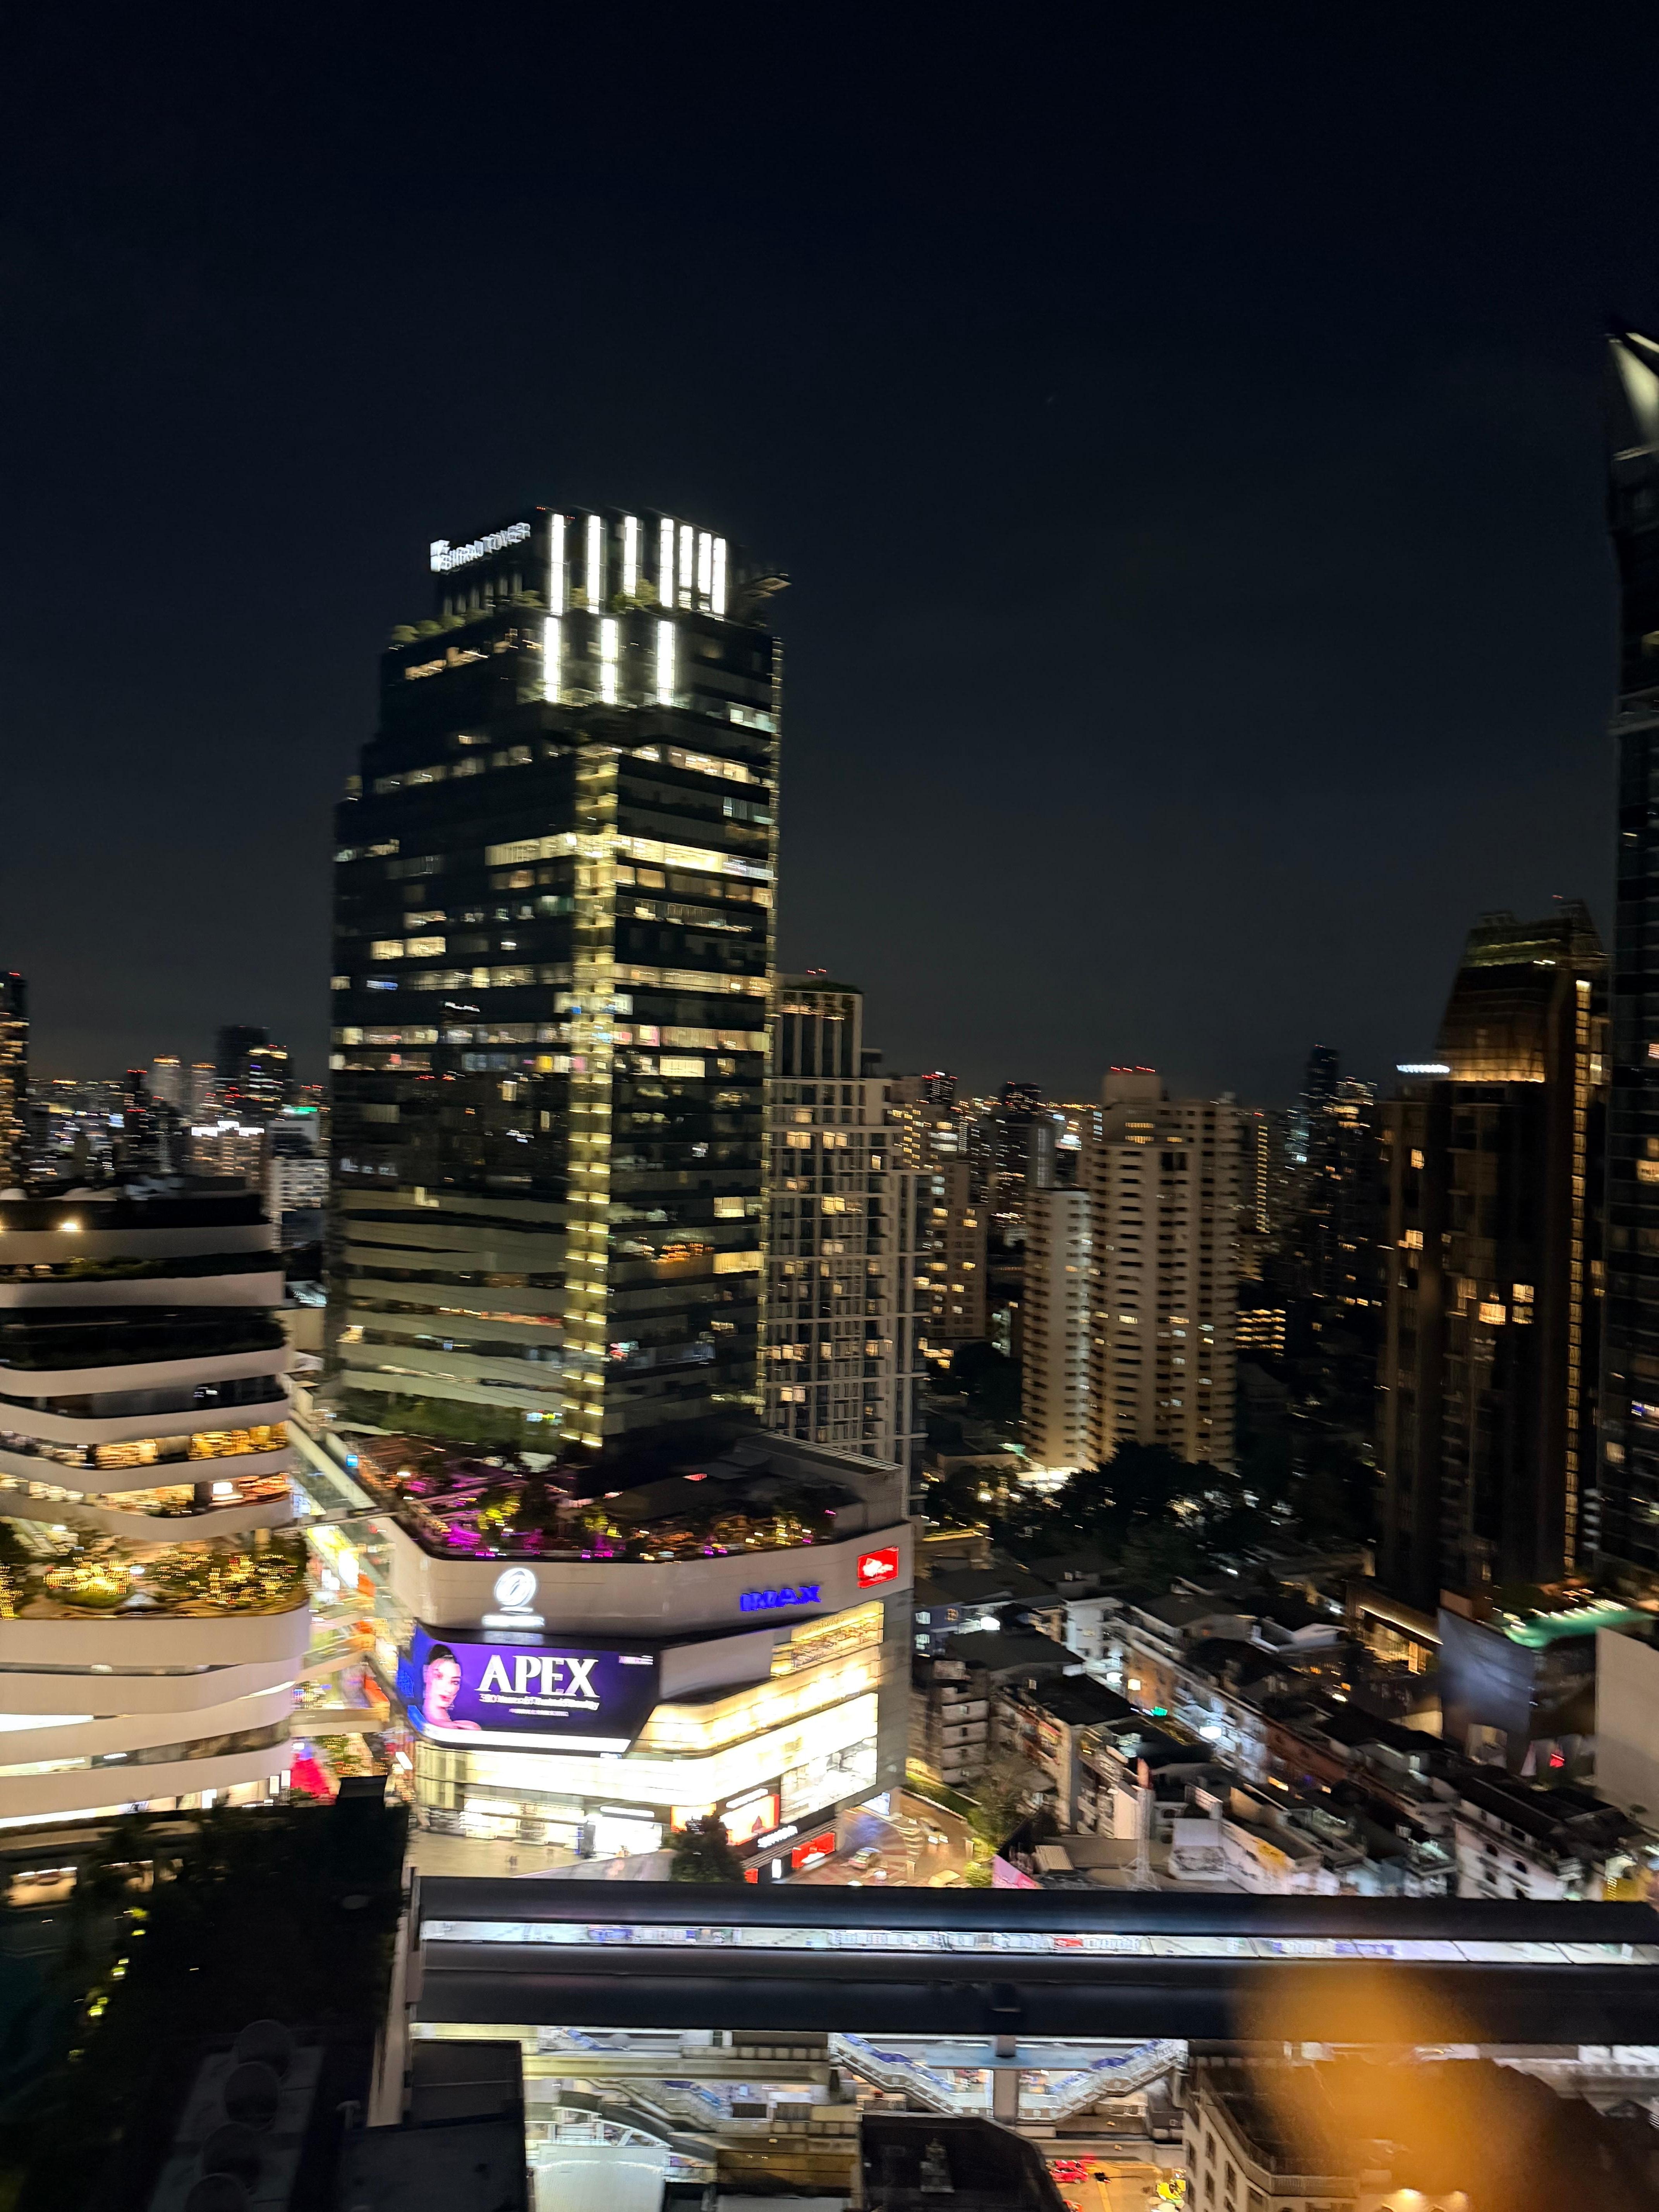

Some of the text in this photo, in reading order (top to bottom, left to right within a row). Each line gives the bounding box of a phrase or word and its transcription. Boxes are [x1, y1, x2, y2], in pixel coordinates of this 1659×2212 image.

[480, 522, 531, 554] TOWER
[740, 1585, 821, 1612] IMAX
[474, 1654, 600, 1698] APEX
